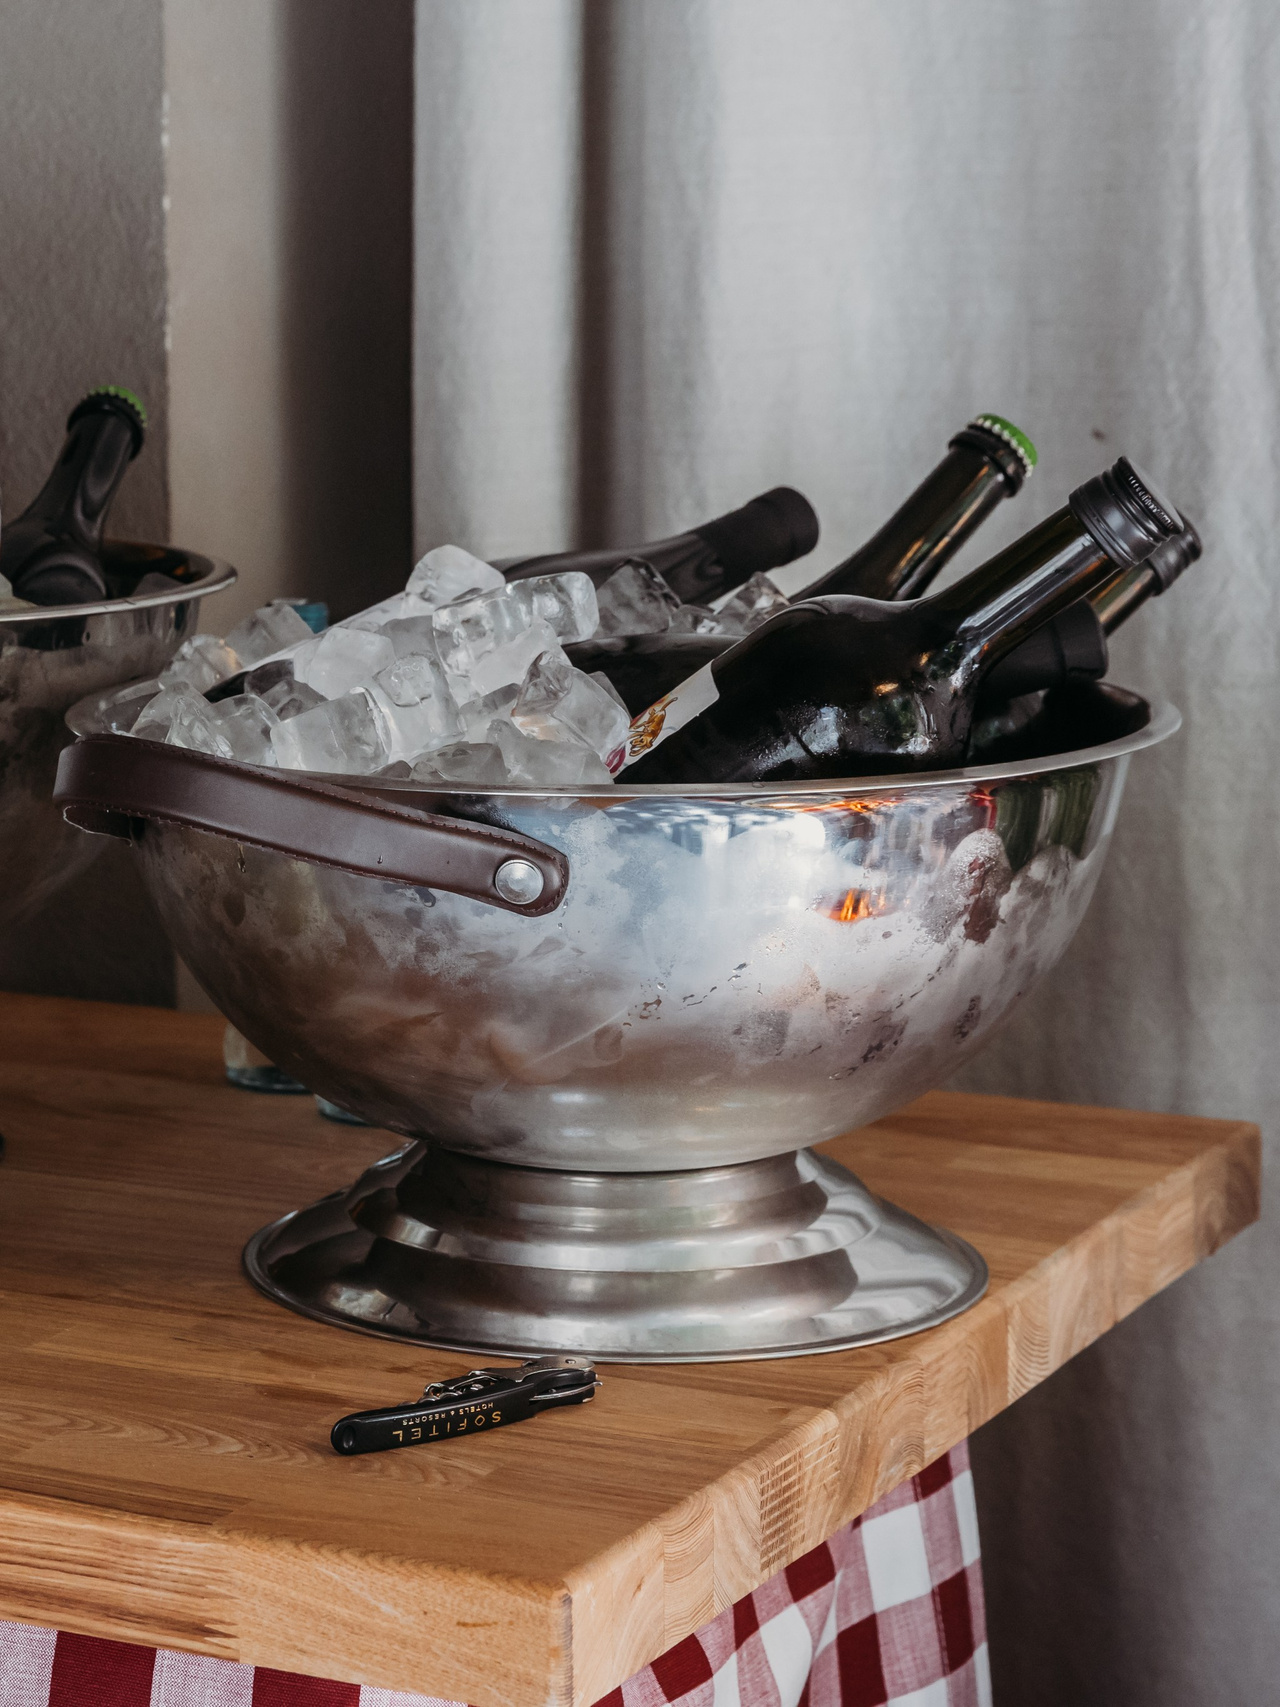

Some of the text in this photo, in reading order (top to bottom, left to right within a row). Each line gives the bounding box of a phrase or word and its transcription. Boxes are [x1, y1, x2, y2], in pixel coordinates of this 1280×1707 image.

[459, 1402, 494, 1415] HOTELS
[392, 1410, 502, 1442] SOFITEL
[402, 1412, 446, 1426] RESORTS
